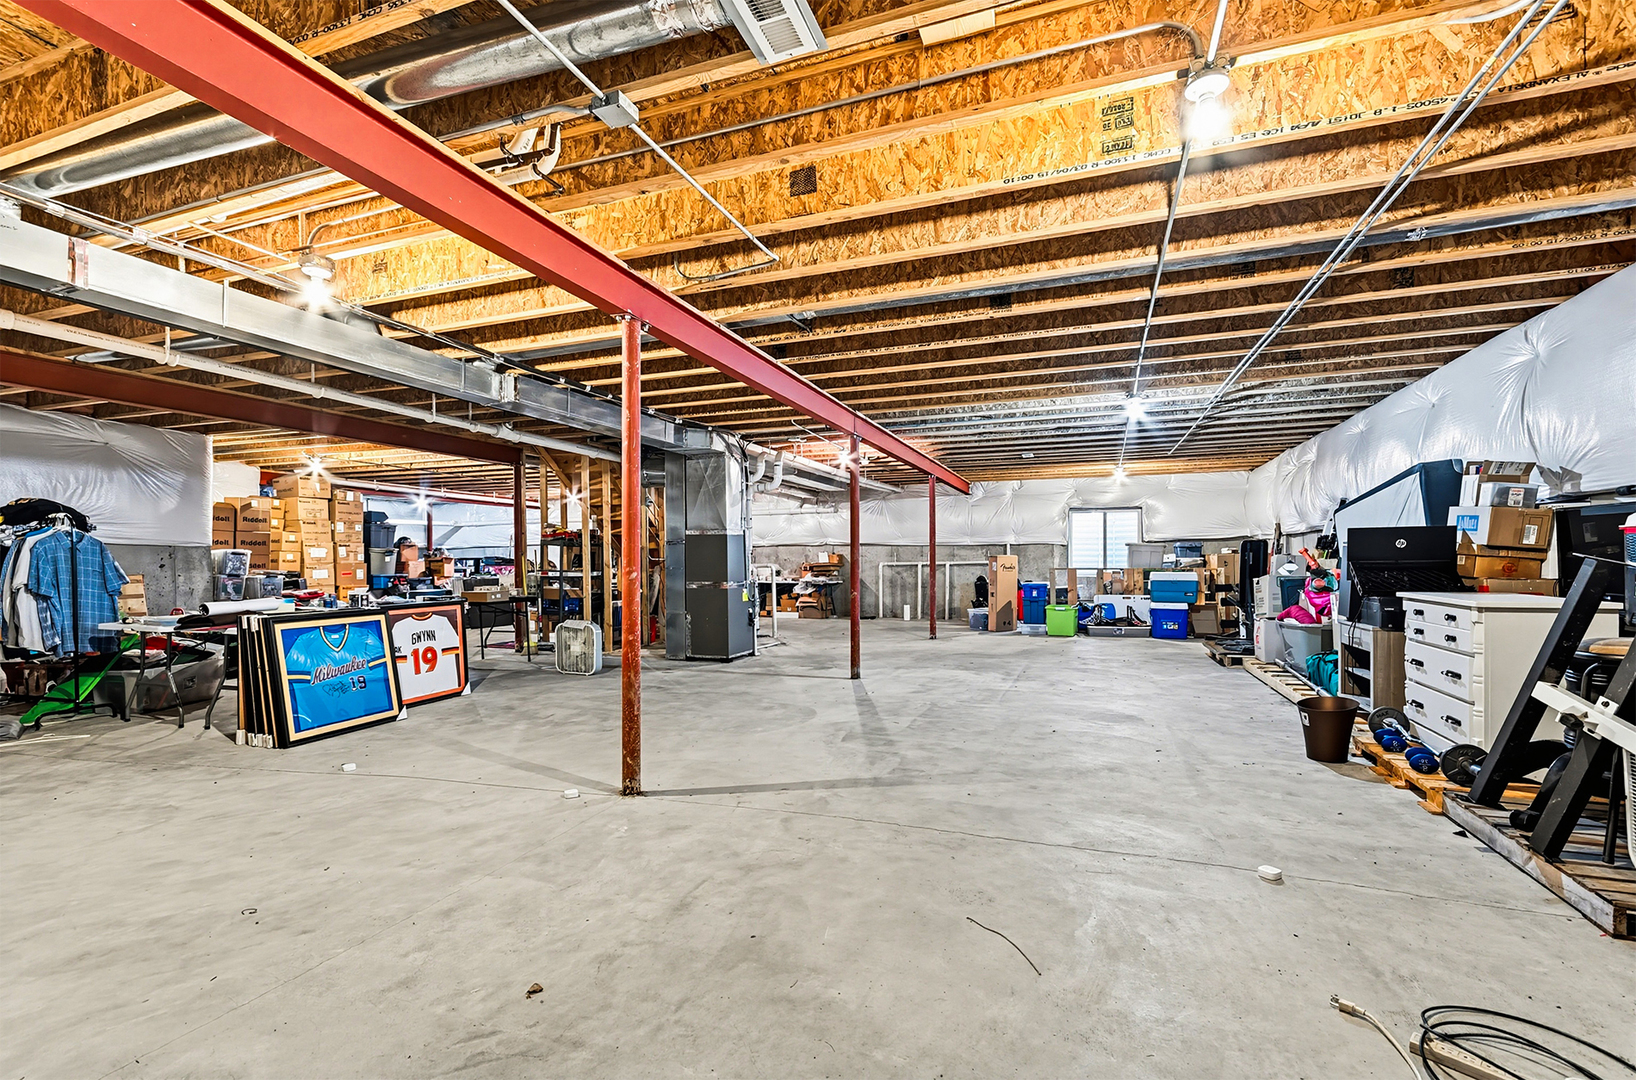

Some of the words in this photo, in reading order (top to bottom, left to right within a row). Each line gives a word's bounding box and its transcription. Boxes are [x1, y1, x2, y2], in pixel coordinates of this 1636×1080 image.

[1497, 70, 1590, 94] ALEXANDRIA
[1326, 111, 1367, 125] JOIST
[1002, 174, 1034, 185] 00:10
[411, 630, 437, 645] GWYNN
[411, 646, 438, 675] 19
[310, 656, 367, 686] Milwaukee
[349, 675, 367, 691] 19
